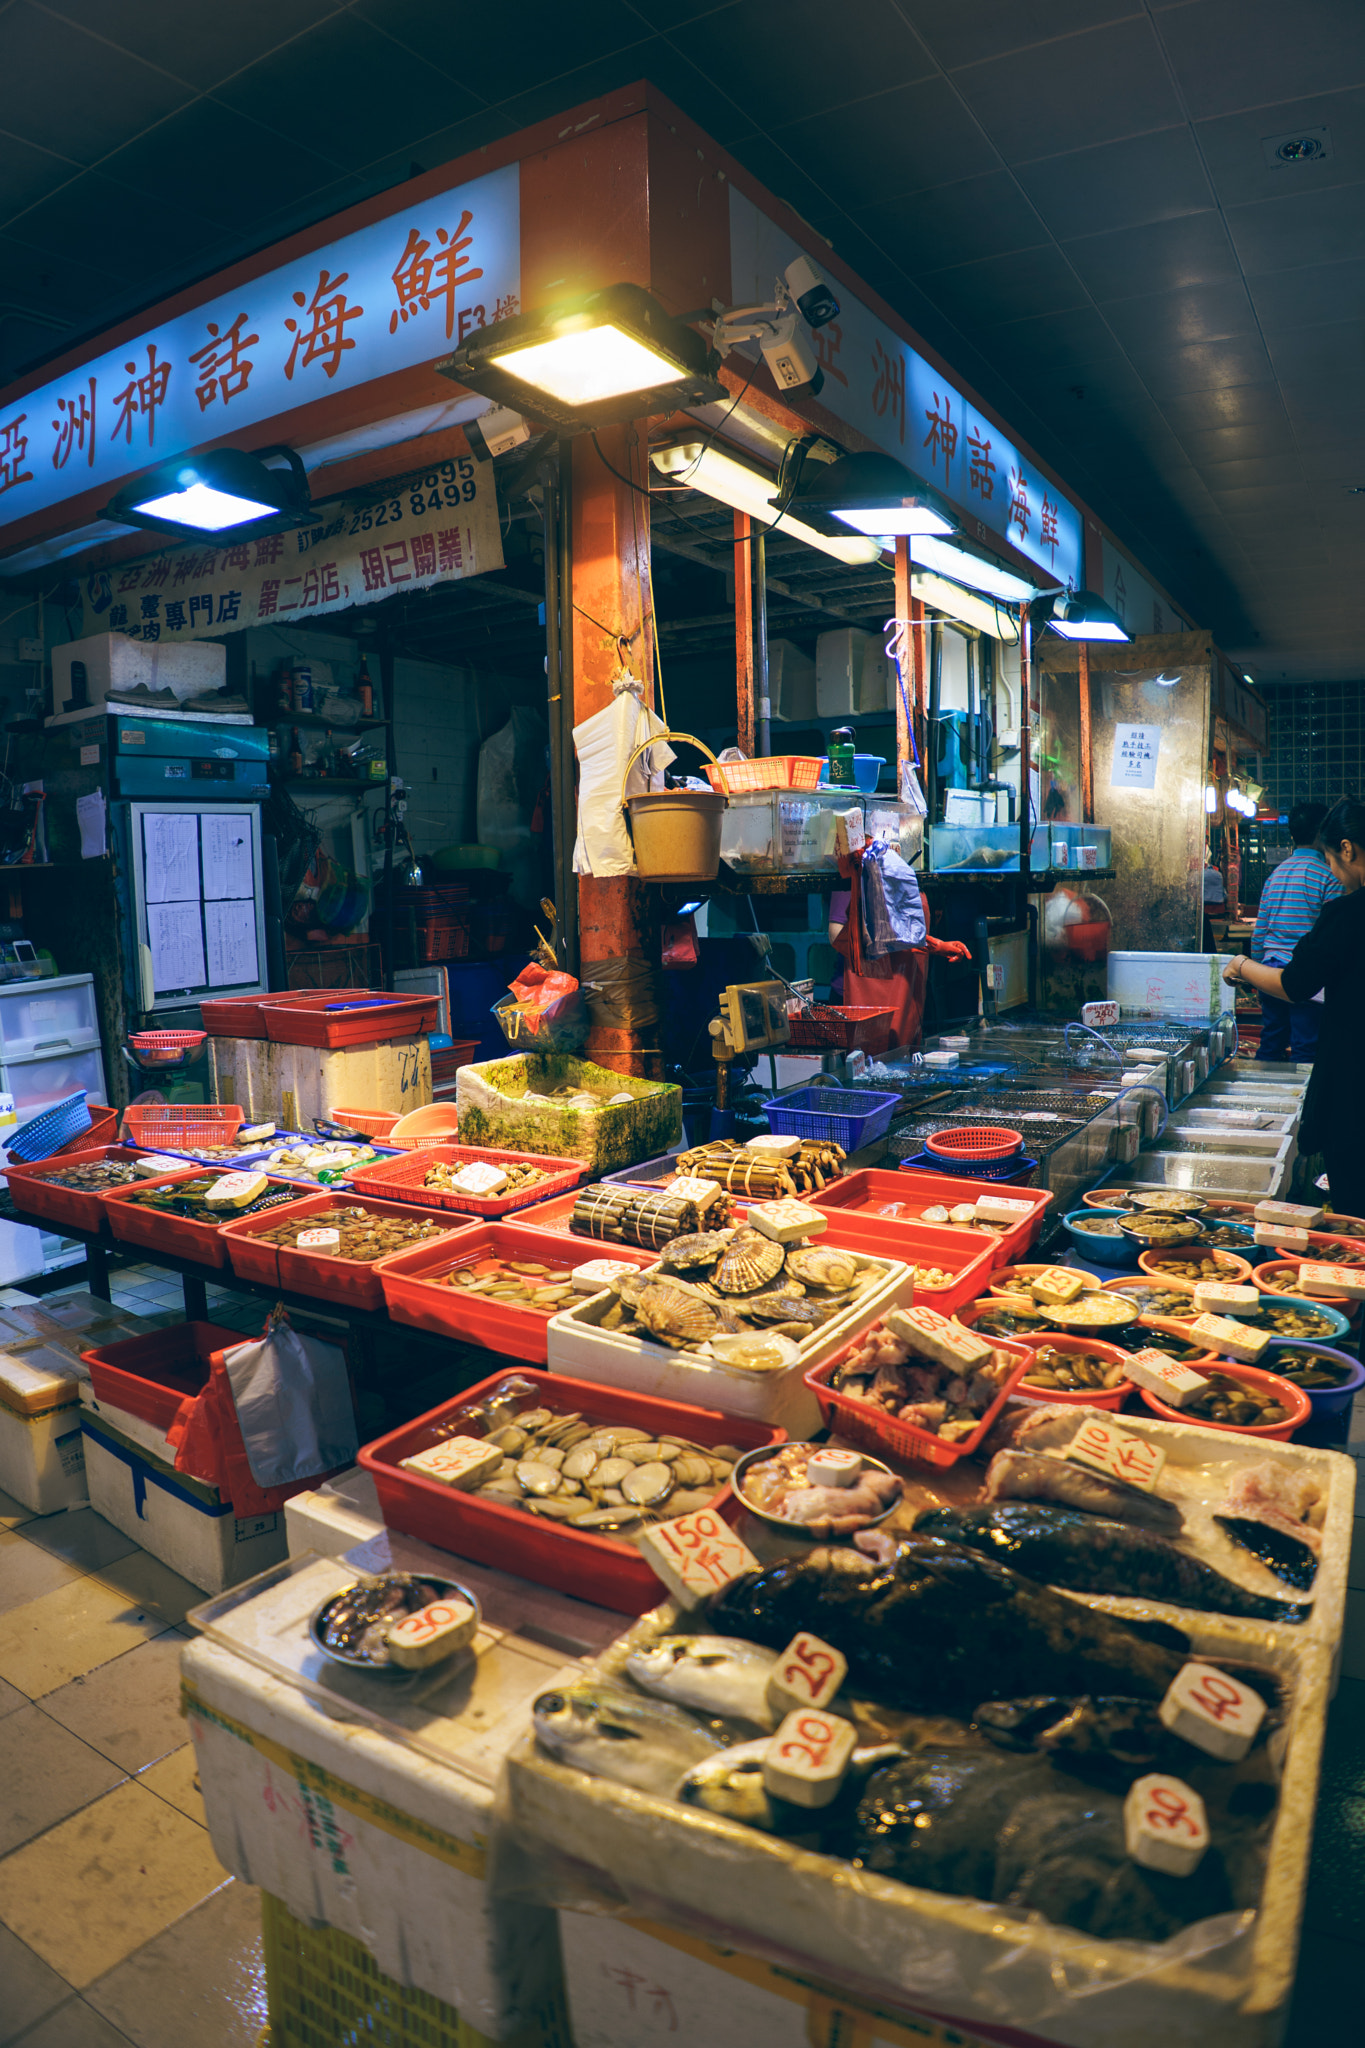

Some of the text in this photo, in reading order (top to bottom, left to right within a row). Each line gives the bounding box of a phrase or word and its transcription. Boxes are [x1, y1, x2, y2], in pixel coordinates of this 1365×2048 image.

[0, 210, 484, 493] 亞洲神話海鮮
[349, 500, 403, 536] 2523
[409, 480, 477, 516] 8499
[760, 1200, 795, 1215] 65
[303, 1229, 329, 1237] 60
[1041, 1269, 1072, 1293] 25
[902, 1308, 948, 1331] 68
[1075, 1427, 1110, 1460] 110
[660, 1515, 721, 1556] 150
[395, 1606, 458, 1641] 30
[784, 1638, 836, 1694] 25
[1188, 1674, 1243, 1722] 40
[780, 1716, 833, 1767] 20
[1148, 1787, 1199, 1838] 30
